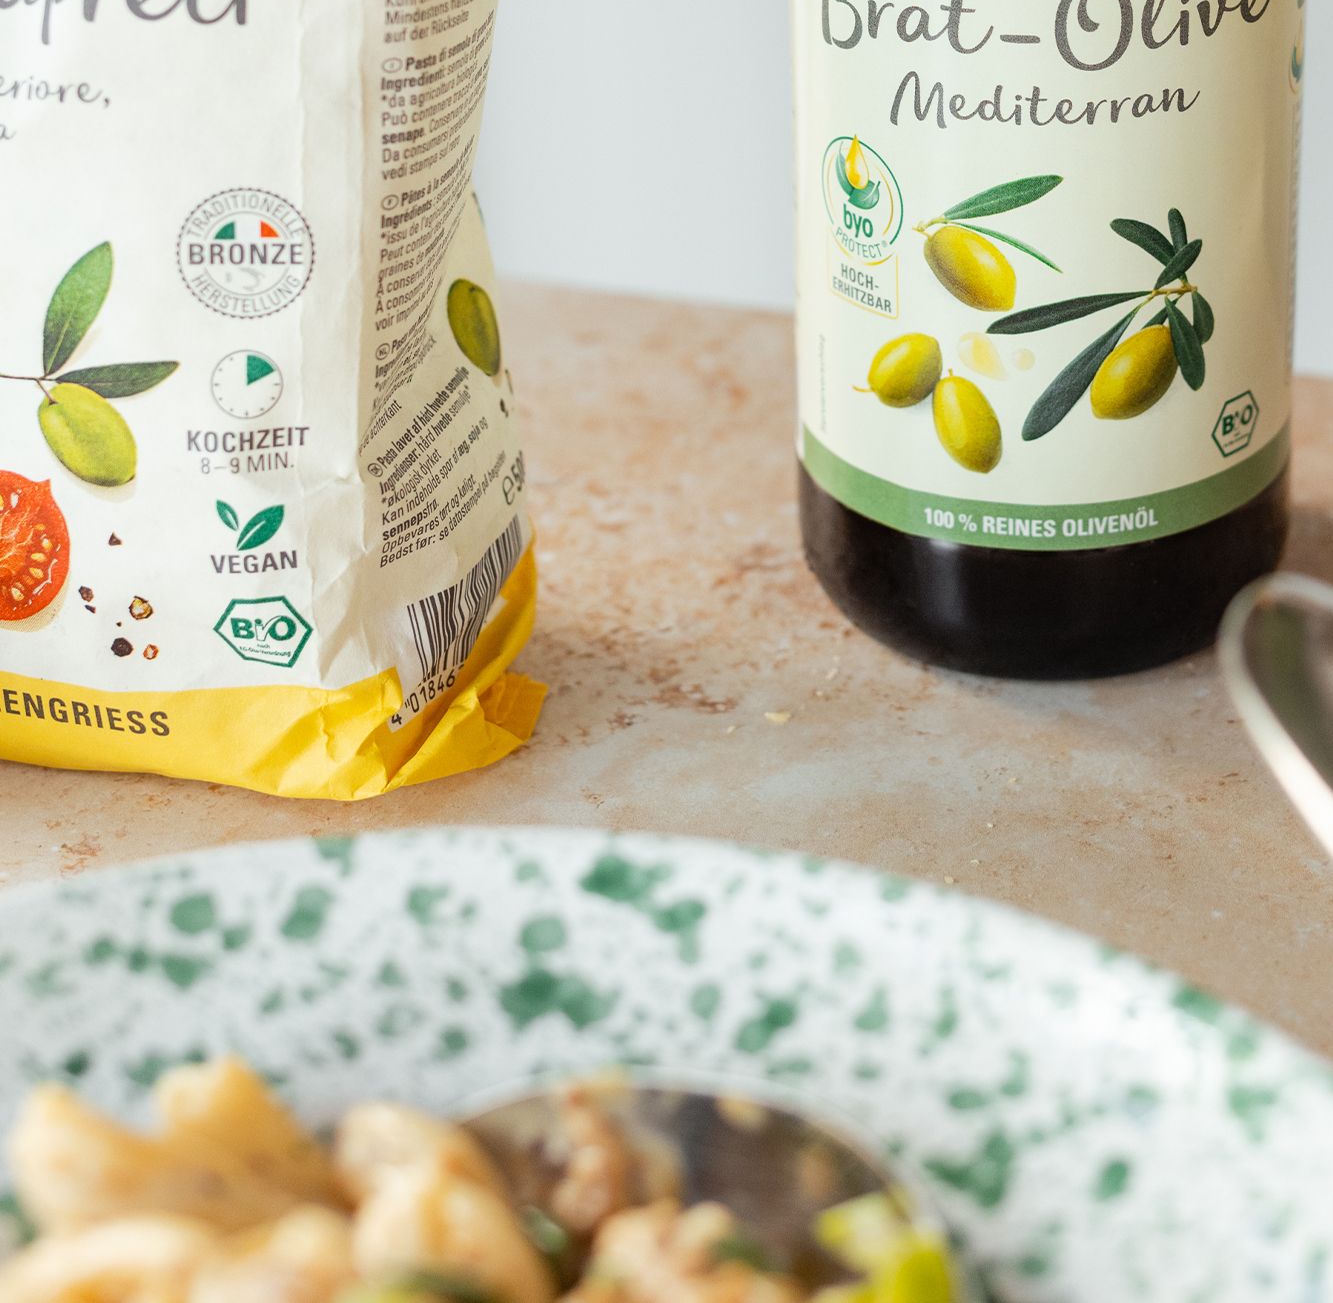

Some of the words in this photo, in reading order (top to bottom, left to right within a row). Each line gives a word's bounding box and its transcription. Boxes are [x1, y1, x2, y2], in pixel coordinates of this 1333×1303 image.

[384, 28, 408, 44] auf
[410, 27, 428, 41] der
[431, 10, 469, 34] Rückseite
[385, 0, 450, 25] Mindestens
[405, 54, 437, 71] Pasta
[439, 47, 447, 62] di
[448, 35, 471, 56] semola
[410, 79, 455, 107] agricoltura
[889, 70, 1201, 129] Mediterran
[382, 110, 408, 126] Può
[412, 97, 452, 123] contenere
[382, 147, 400, 163] Da
[403, 131, 448, 160] consumarsi
[381, 165, 408, 181] vedi
[410, 152, 438, 174] stampa
[439, 147, 448, 160] sul
[401, 187, 425, 207] Pâtes
[433, 177, 439, 191] la
[187, 194, 305, 238] TRADITIONELLE
[409, 222, 419, 237] de
[843, 203, 873, 238] byo
[188, 244, 303, 264] BRONZE
[378, 257, 414, 282] graines
[380, 247, 404, 264] Peut
[841, 263, 879, 290] HOCH-
[192, 274, 300, 312] HERSTELLUNG
[832, 276, 892, 313] ERHITZBAR
[375, 313, 394, 332] voir
[377, 447, 398, 469] Pasta
[394, 428, 415, 455] lavet
[412, 418, 422, 435] af
[428, 390, 450, 415] hvede
[446, 365, 469, 394] semulje
[187, 427, 309, 453] KOCHZEIT
[379, 449, 421, 495] Ingredienser:
[417, 432, 436, 455] hård
[431, 412, 453, 437] hvede
[247, 451, 294, 473] MIN.
[421, 448, 443, 478] dyrket
[382, 505, 404, 526] Kan
[406, 473, 441, 511] indeholde
[440, 458, 454, 480] spor
[380, 542, 413, 568] Bedst
[416, 533, 436, 553] før:
[439, 527, 450, 542] se
[449, 483, 483, 535] datostempel
[382, 498, 439, 541] sennepsfrø.
[382, 518, 440, 554] Opbevares
[439, 502, 451, 522] tørt
[451, 496, 460, 510] og
[923, 507, 954, 528] 100
[959, 514, 977, 532] %
[982, 516, 1056, 537] REINES
[1062, 506, 1159, 537] OLIVENÖL
[210, 550, 298, 573] VEGAN
[0, 689, 170, 737] ENGRIESS
[391, 713, 402, 725] 4
